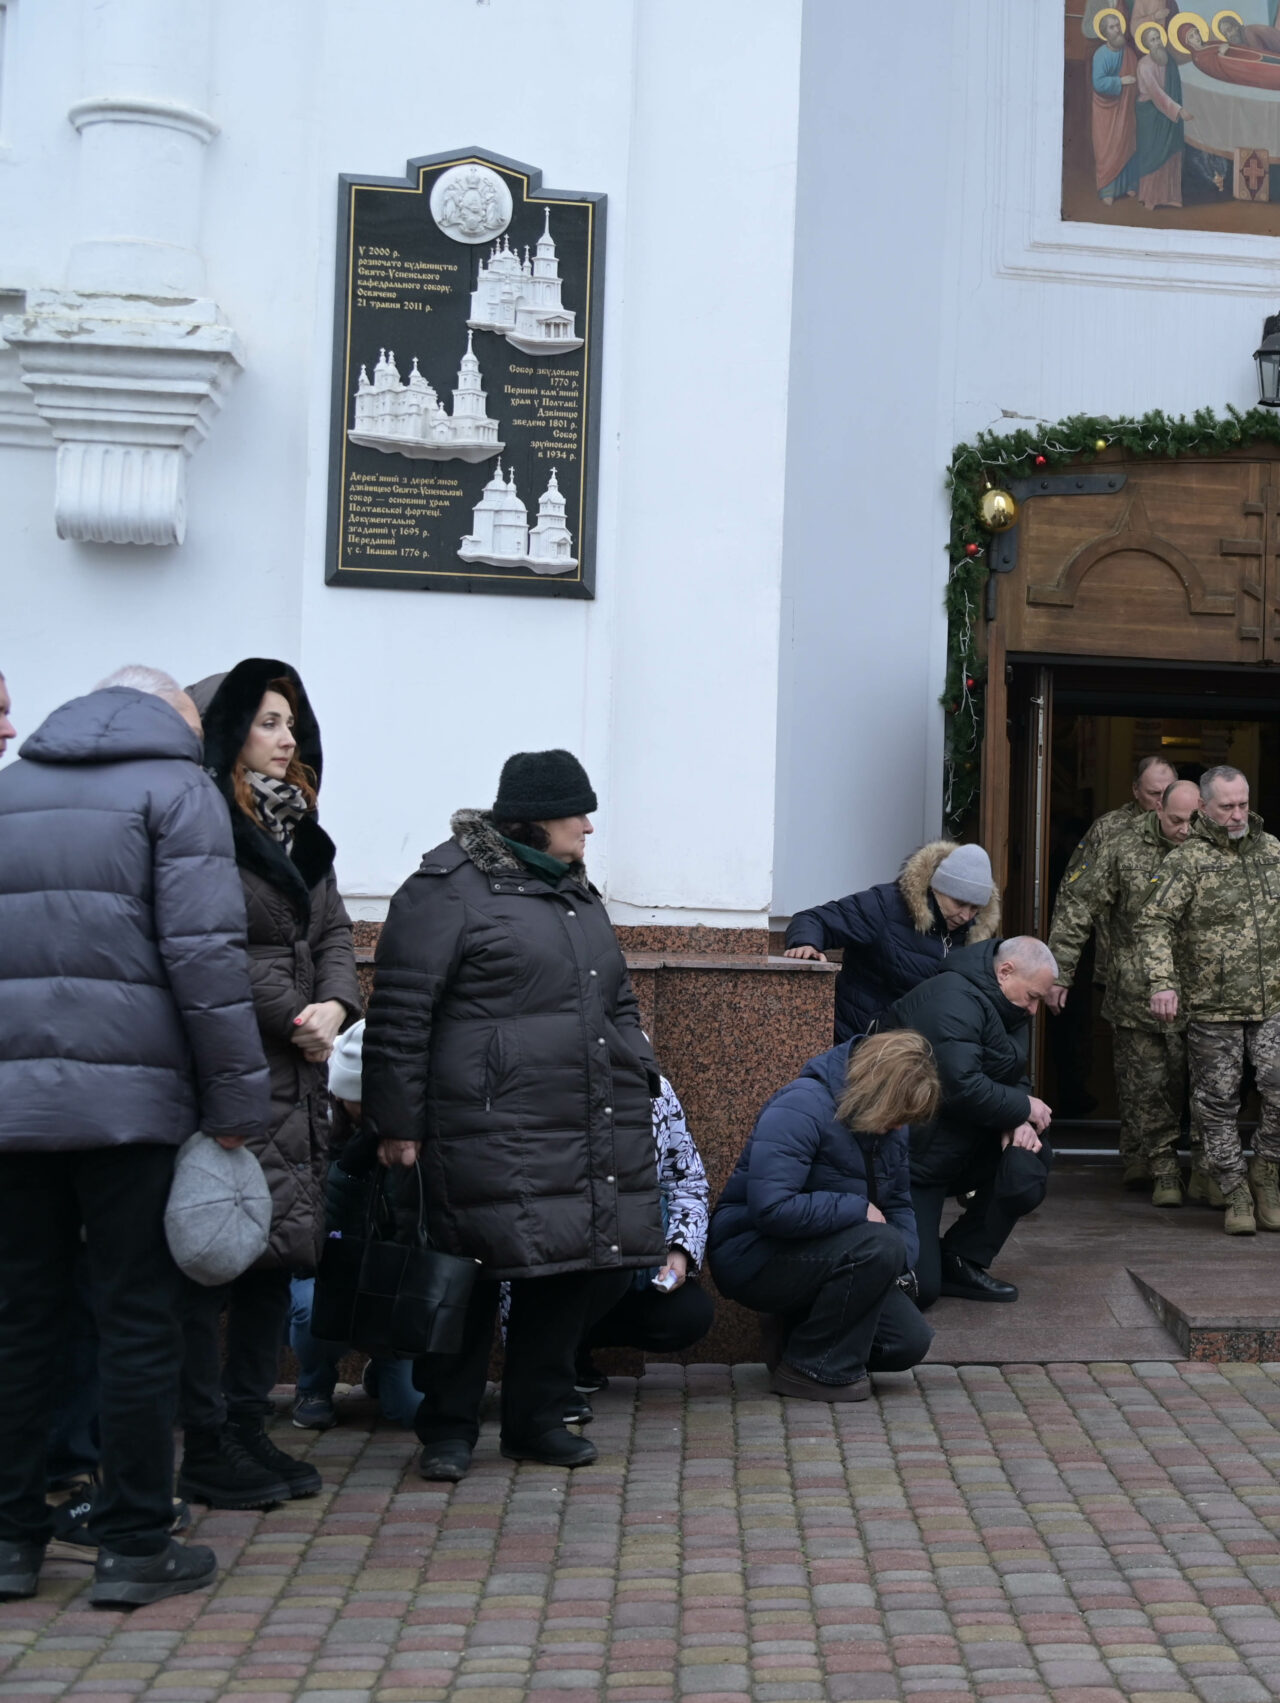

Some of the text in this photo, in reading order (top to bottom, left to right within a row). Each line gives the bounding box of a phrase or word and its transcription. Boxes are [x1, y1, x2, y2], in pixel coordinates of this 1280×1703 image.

[358, 246, 365, 256] У
[369, 247, 390, 256] 2000
[358, 259, 457, 271] розпочато будівництво
[358, 267, 440, 280] Свято-Успенського
[358, 278, 452, 293] кафедрального собору.
[358, 288, 396, 298] Освячено
[370, 301, 400, 309] травня
[404, 301, 422, 310] 2011
[509, 364, 579, 377] Собор збудовано
[550, 378, 569, 386] 1770
[504, 385, 537, 395] Перший
[511, 398, 577, 407] храм у Полтаві.
[537, 408, 577, 419] Дзвіницю
[512, 419, 577, 430] зведено 1801 р.
[553, 430, 577, 440] Собор
[530, 440, 577, 449] зруйновано
[570, 453, 576, 461] р.
[349, 484, 391, 492] дзвіницею
[349, 495, 372, 503] собор
[349, 503, 441, 517] Полтавської фортеці.
[349, 514, 415, 525] Документально
[348, 526, 388, 534] згаданий
[400, 527, 419, 535] 1695
[422, 530, 429, 538] р.
[348, 535, 395, 545] Переданий
[366, 546, 397, 555] Івашки
[401, 548, 419, 556] 1776
